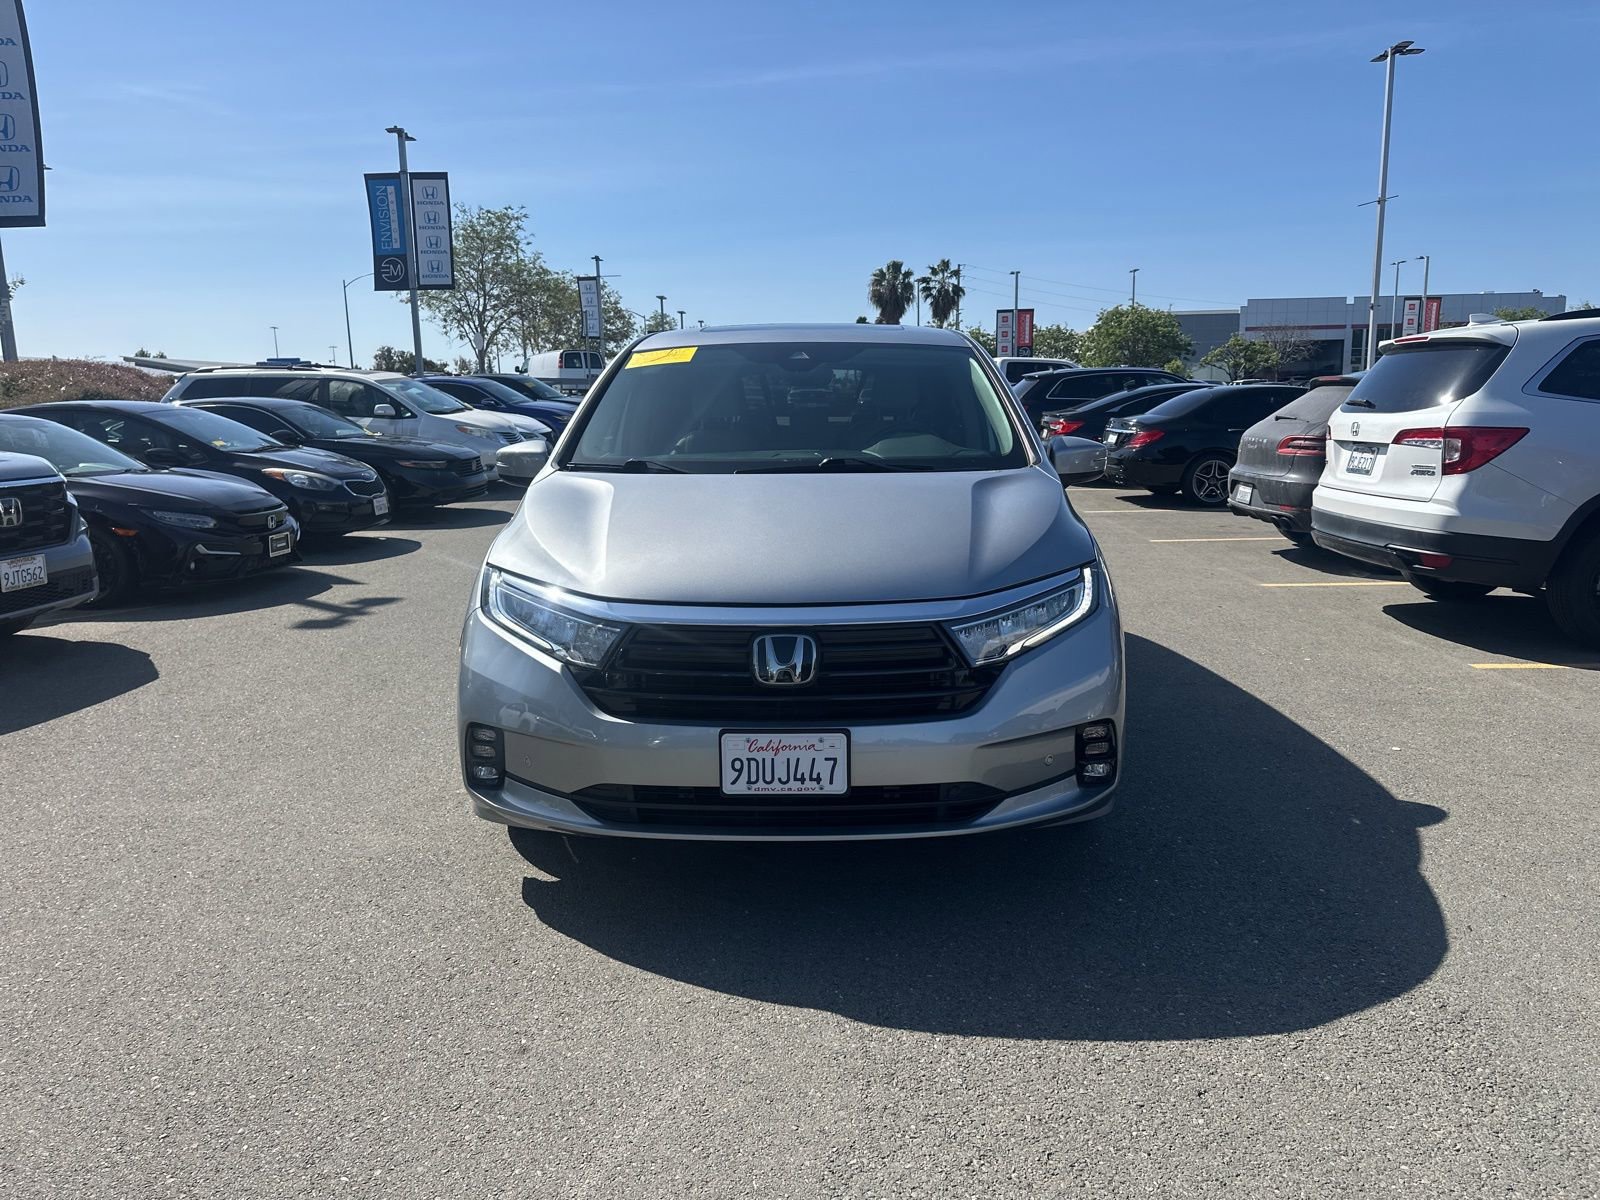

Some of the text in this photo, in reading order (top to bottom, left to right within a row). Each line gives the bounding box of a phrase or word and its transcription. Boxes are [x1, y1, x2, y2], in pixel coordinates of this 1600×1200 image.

[0, 195, 33, 203] NDA
[376, 185, 393, 250] ENVISION
[4, 566, 44, 587] 9JTG562
[748, 739, 817, 756] California
[730, 757, 838, 785] 9DUJ447
